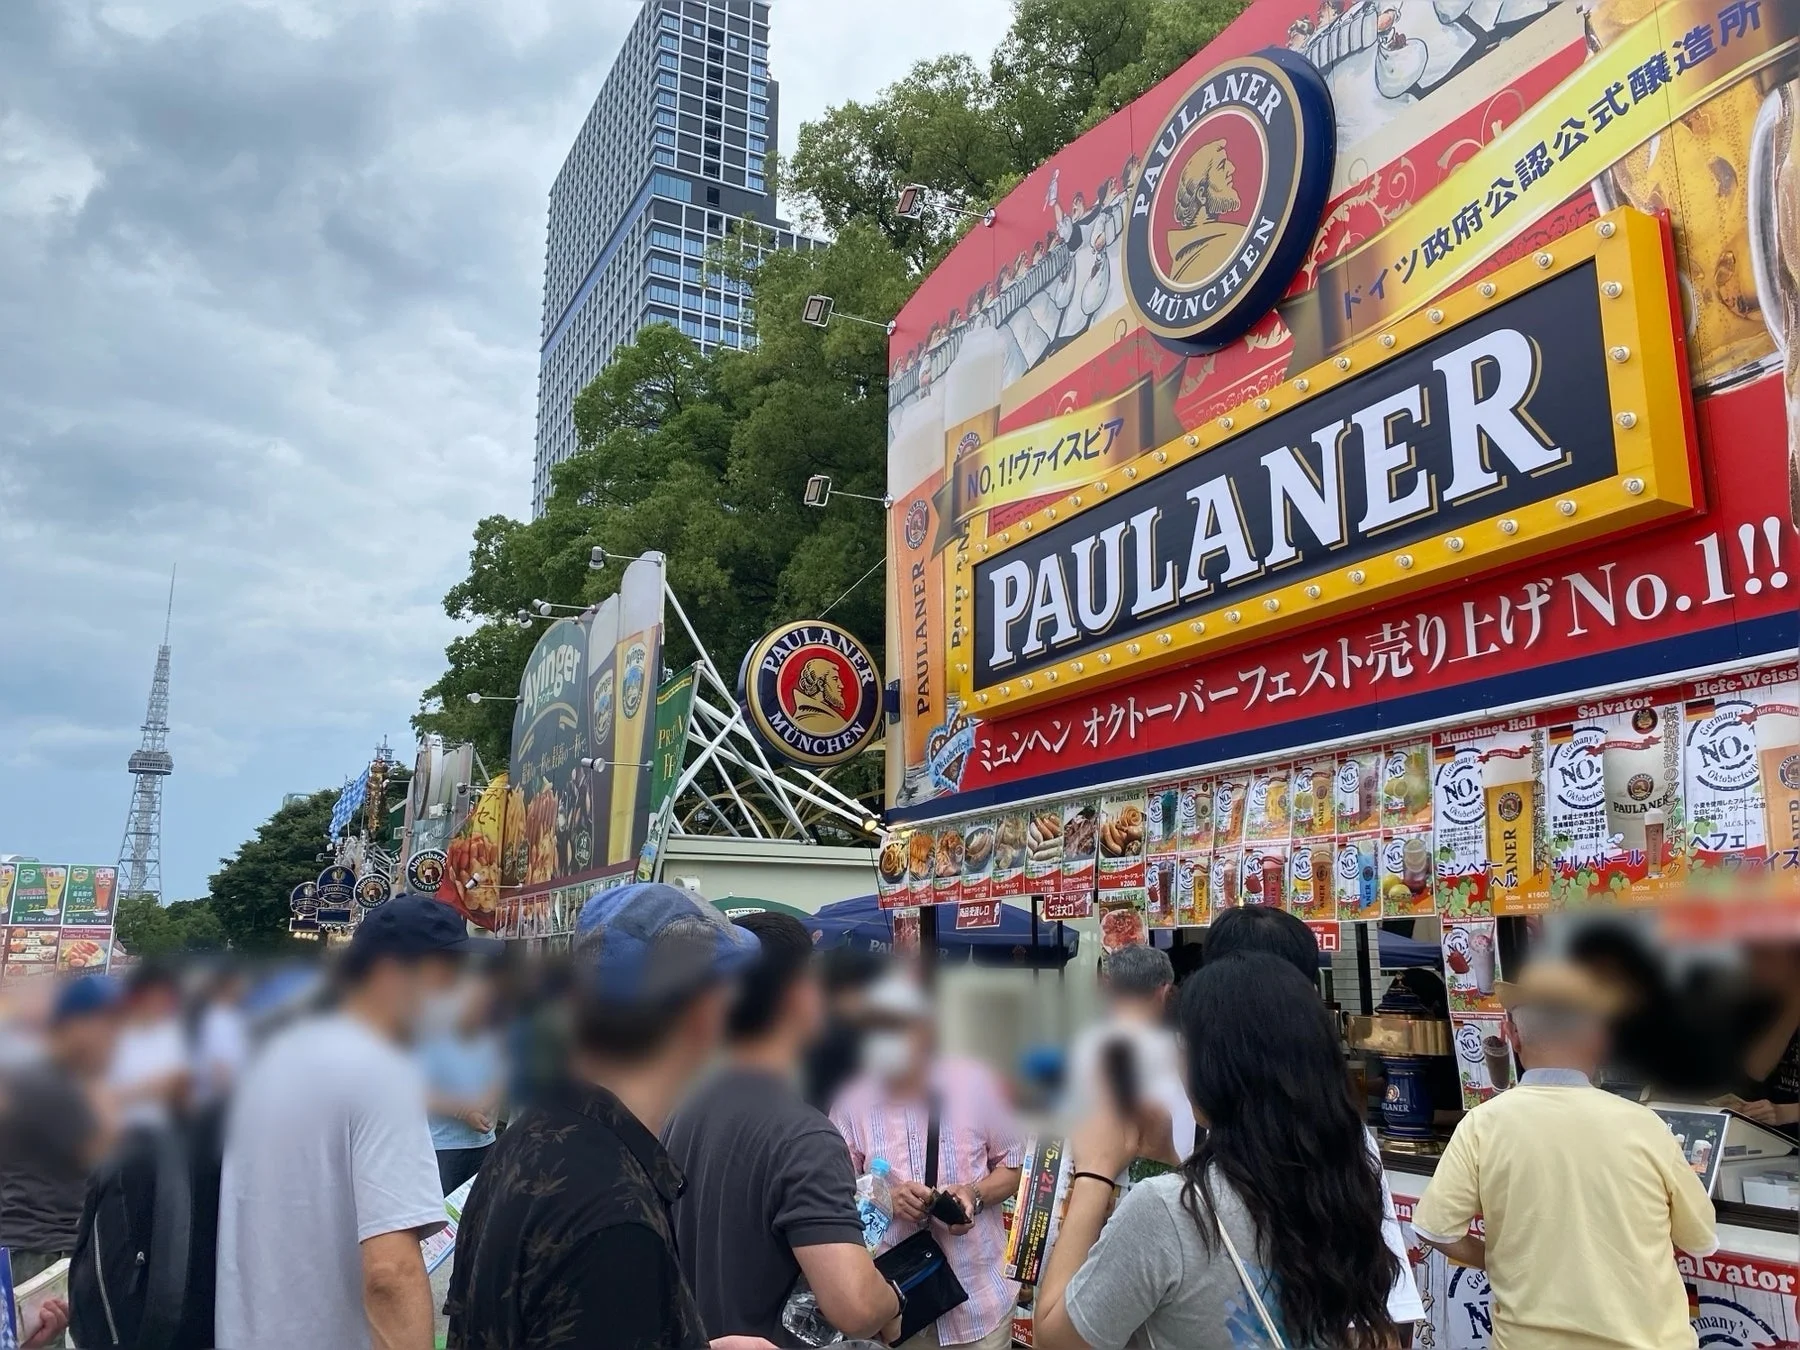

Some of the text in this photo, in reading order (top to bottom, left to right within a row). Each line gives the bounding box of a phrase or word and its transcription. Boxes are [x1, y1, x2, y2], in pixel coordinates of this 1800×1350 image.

[1132, 72, 1283, 218] PAULANER
[1343, 0, 1762, 320] ドイツ政府公認公式醸造所
[1147, 215, 1276, 322] MÜNCHEN
[988, 328, 1566, 668] PAULANER
[911, 560, 931, 718] PAULANER
[762, 628, 875, 687] PAULANER
[522, 645, 581, 725] Ayinger
[1694, 666, 1800, 697] Hefe-Weiss
[1577, 696, 1653, 718] Salvator
[768, 711, 866, 754] MÜNCHEN
[1439, 715, 1537, 744] Munchner Hell
[1699, 708, 1744, 737] Germany'
[979, 720, 1071, 772] ミュンヘン
[1560, 734, 1600, 759] Germany's
[1558, 758, 1601, 789] NO.
[1613, 793, 1668, 814] PAULANER
[1690, 832, 1746, 850] ヘフェ
[1437, 859, 1503, 878] ミュンヘナー
[1552, 848, 1645, 873] サルバトール
[1491, 873, 1518, 888] ヘル
[1047, 893, 1065, 903] フード
[1048, 904, 1074, 916] ご注文口
[1678, 1256, 1796, 1293] alvator
[1690, 1315, 1750, 1340] rmany's
